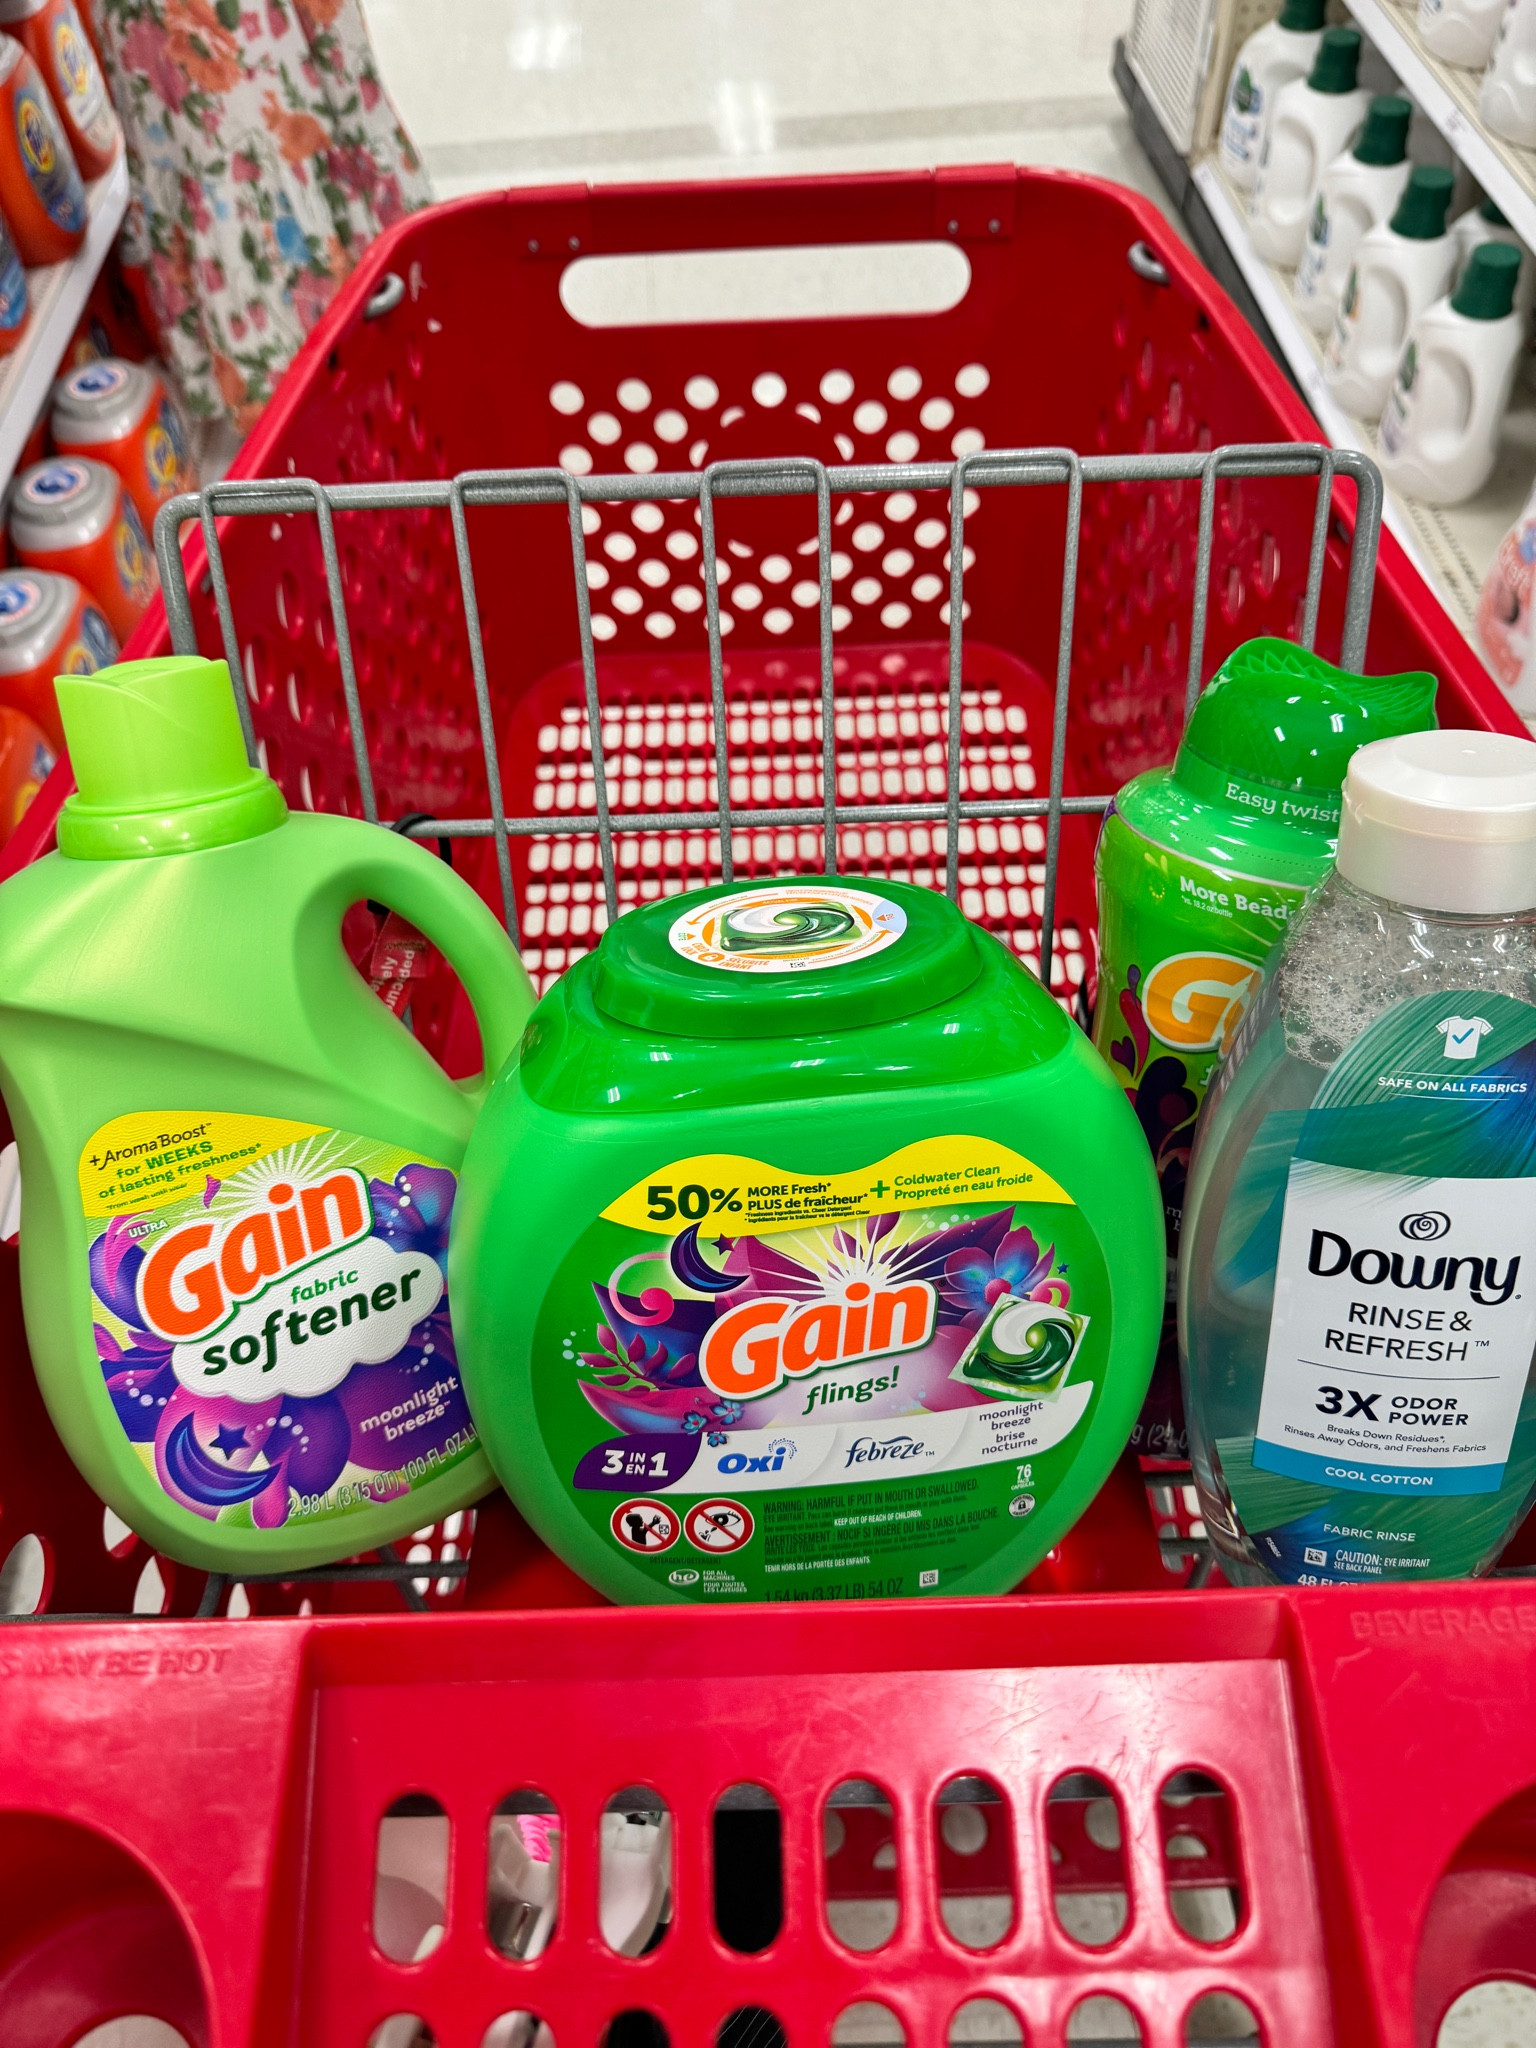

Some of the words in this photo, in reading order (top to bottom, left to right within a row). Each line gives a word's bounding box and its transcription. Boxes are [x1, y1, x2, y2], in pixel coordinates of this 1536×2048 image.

[1225, 782, 1277, 815] Easy
[1282, 799, 1340, 824] twist
[1180, 875, 1229, 906] More
[1378, 1076, 1413, 1089] SAFE
[1416, 1079, 1438, 1091] ON
[1442, 1082, 1467, 1092] ALL
[1469, 1082, 1528, 1093] FABRICS
[116, 1164, 141, 1180] for
[145, 1140, 213, 1170] WEEKS
[98, 1185, 118, 1199] of
[120, 1170, 176, 1195] lasting
[894, 1167, 961, 1187] Coldwater
[964, 1165, 1001, 1180] Clean
[894, 1183, 951, 1200] Propreté
[953, 1183, 969, 1193] en
[971, 1180, 993, 1191] eau
[996, 1171, 1033, 1188] froide
[646, 1184, 742, 1221] 50%
[748, 1184, 788, 1197] MORE
[748, 1199, 782, 1211] PLUS
[784, 1198, 801, 1209] de
[127, 1218, 168, 1238] ULTRA
[142, 1174, 363, 1336] Gain
[1308, 1228, 1521, 1306] Downy
[290, 1267, 359, 1304] fabric
[203, 1268, 421, 1374] softener
[1348, 1302, 1446, 1331] RINSE
[1449, 1311, 1473, 1332] &
[705, 1281, 930, 1394] Gain
[360, 1376, 459, 1433] moonlight
[802, 1365, 899, 1416] flings!
[1315, 1385, 1383, 1422] 3X
[1391, 1396, 1459, 1411] ODOR
[979, 1401, 1044, 1422] moonlight
[991, 1415, 1032, 1430] breeze
[1388, 1411, 1469, 1426] POWER
[981, 1437, 1038, 1455] nocturne
[995, 1430, 1025, 1443] brise
[1284, 1424, 1315, 1440] Rinses
[1317, 1432, 1345, 1446] Away
[1347, 1438, 1382, 1451] Odors,
[1384, 1442, 1404, 1452] and
[1406, 1443, 1450, 1453] Freshens
[1452, 1443, 1487, 1453] Fabrics
[1327, 1423, 1360, 1437] Breaks
[1363, 1429, 1393, 1441] Down
[287, 1493, 321, 1518] 2.98
[324, 1490, 335, 1511] L
[337, 1480, 370, 1510] (3.15
[374, 1469, 400, 1496] QT)
[402, 1456, 427, 1482] 100
[426, 1447, 447, 1468] FL
[445, 1431, 466, 1456] OZ
[601, 1449, 624, 1476] 3
[629, 1452, 646, 1463] IN
[648, 1451, 669, 1477] 1
[625, 1464, 646, 1476] EN
[717, 1446, 786, 1475] Oxi
[1017, 1464, 1032, 1479] 76
[1325, 1466, 1367, 1482] COOL
[1370, 1473, 1434, 1486] COTTON
[764, 1501, 804, 1513] WARNING:
[806, 1496, 845, 1510] HARMFUL
[847, 1494, 855, 1506] IF
[857, 1493, 873, 1506] PUT
[874, 1492, 883, 1504] IN
[885, 1488, 913, 1502] MOUTH
[915, 1486, 926, 1499] OR
[928, 1478, 979, 1497] SWALLOWED.
[764, 1530, 831, 1546] AVERTISSEMENT
[837, 1526, 861, 1540] NOCIF
[863, 1525, 871, 1537] SI
[903, 1521, 914, 1534] OU
[916, 1519, 931, 1532] MIS
[932, 1516, 954, 1530] DANS
[955, 1514, 966, 1525] LA
[834, 1517, 848, 1527] KEEP
[849, 1516, 860, 1525] OUT
[860, 1515, 868, 1524] OF
[868, 1513, 887, 1523] REACH
[887, 1512, 894, 1521] OF
[1323, 1523, 1374, 1541] FABRIC
[1376, 1530, 1417, 1542] RINSE
[764, 1564, 780, 1573] TENIR
[781, 1563, 796, 1572] HORS
[796, 1562, 804, 1570] DE
[804, 1561, 812, 1570] LA
[813, 1559, 833, 1569] PORTÉE
[834, 1558, 845, 1567] DES
[1333, 1561, 1345, 1570] SEE
[1345, 1564, 1362, 1573] BACK
[1363, 1566, 1382, 1575] PANEL
[1335, 1549, 1383, 1566] CAUTION:
[1384, 1557, 1397, 1567] EYE
[1398, 1558, 1431, 1568] IRRITANT
[764, 1589, 790, 1602] 1.54
[811, 1585, 842, 1602] (3.37
[845, 1583, 865, 1600] LB)
[868, 1580, 886, 1596] 54
[887, 1577, 904, 1595] OZ
[1297, 1573, 1318, 1587] 48
[105, 1650, 153, 1676] BE
[158, 1647, 233, 1674] HOT
